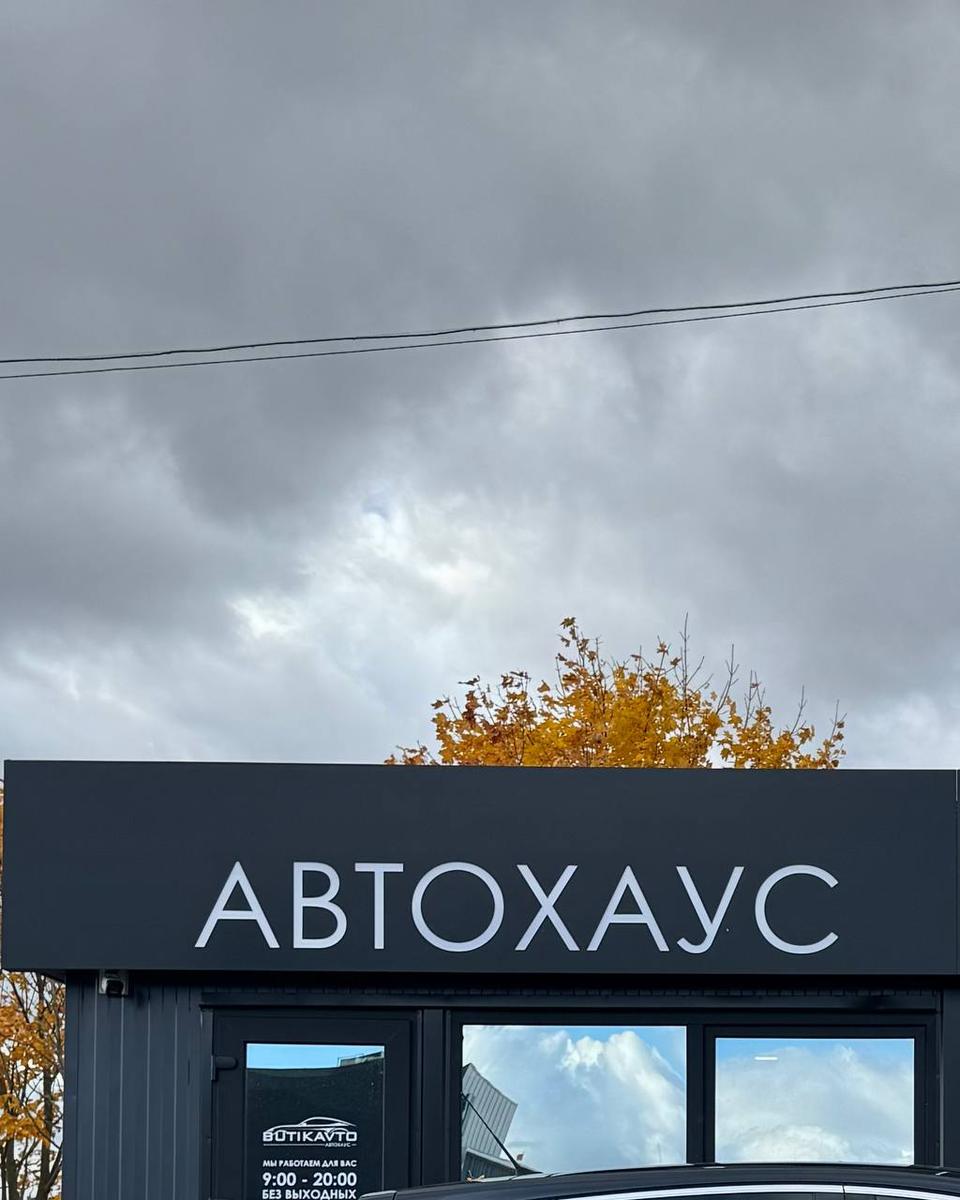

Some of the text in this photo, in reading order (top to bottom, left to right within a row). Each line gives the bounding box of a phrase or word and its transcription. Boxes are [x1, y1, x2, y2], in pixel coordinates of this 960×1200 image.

[195, 860, 840, 955] АВТОХАУС
[262, 1131, 358, 1142] BUTIKAVTO
[262, 1160, 358, 1169] МЫ РАБОТАЕМ ДЛЯ ВАС
[262, 1172, 297, 1187] 9:00
[312, 1172, 358, 1187] 20:00
[262, 1189, 357, 1200] БЕЗ ВЫХОДНЫХ
